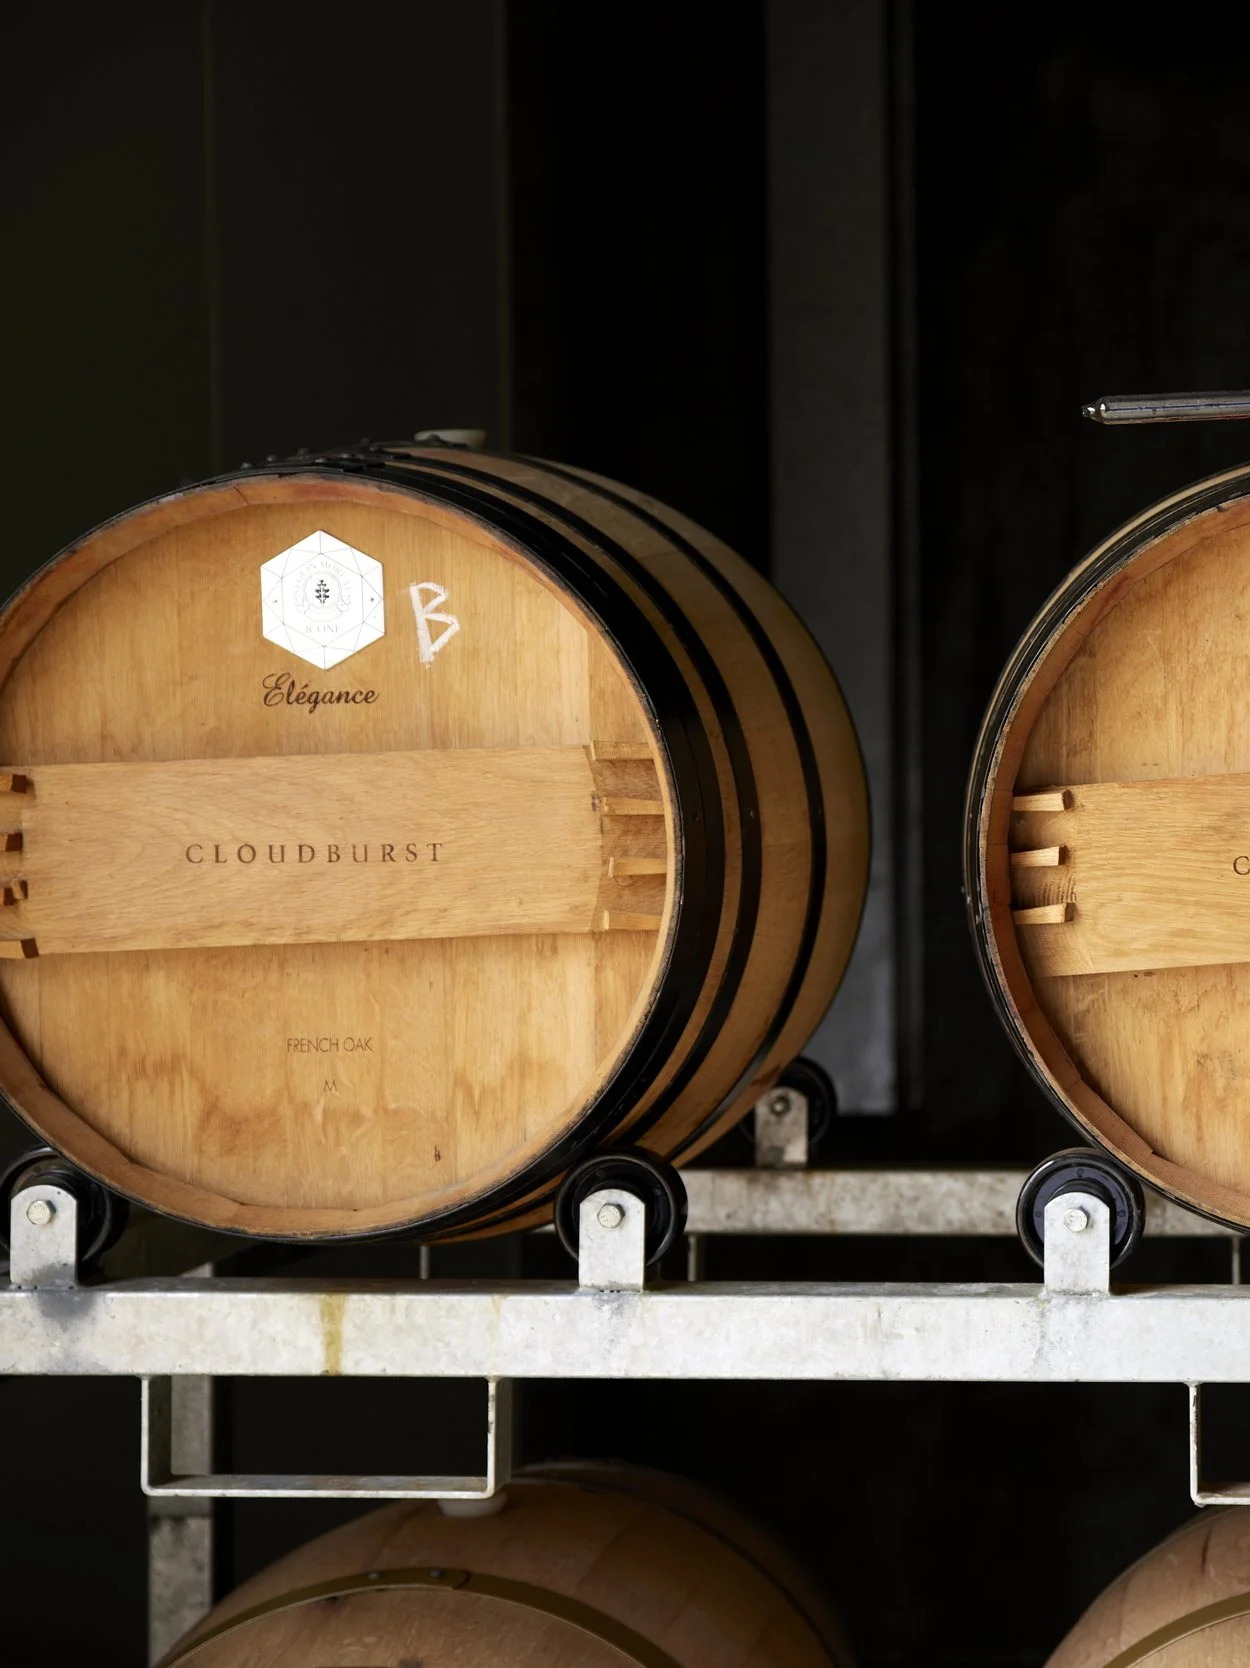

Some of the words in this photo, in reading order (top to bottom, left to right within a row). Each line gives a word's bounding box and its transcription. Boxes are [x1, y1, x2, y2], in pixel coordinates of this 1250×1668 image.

[409, 582, 460, 666] B
[185, 842, 443, 864] CLOUDBURST
[287, 1037, 339, 1053] FRENCH
[343, 1036, 373, 1052] OAK
[323, 1079, 338, 1093] M
